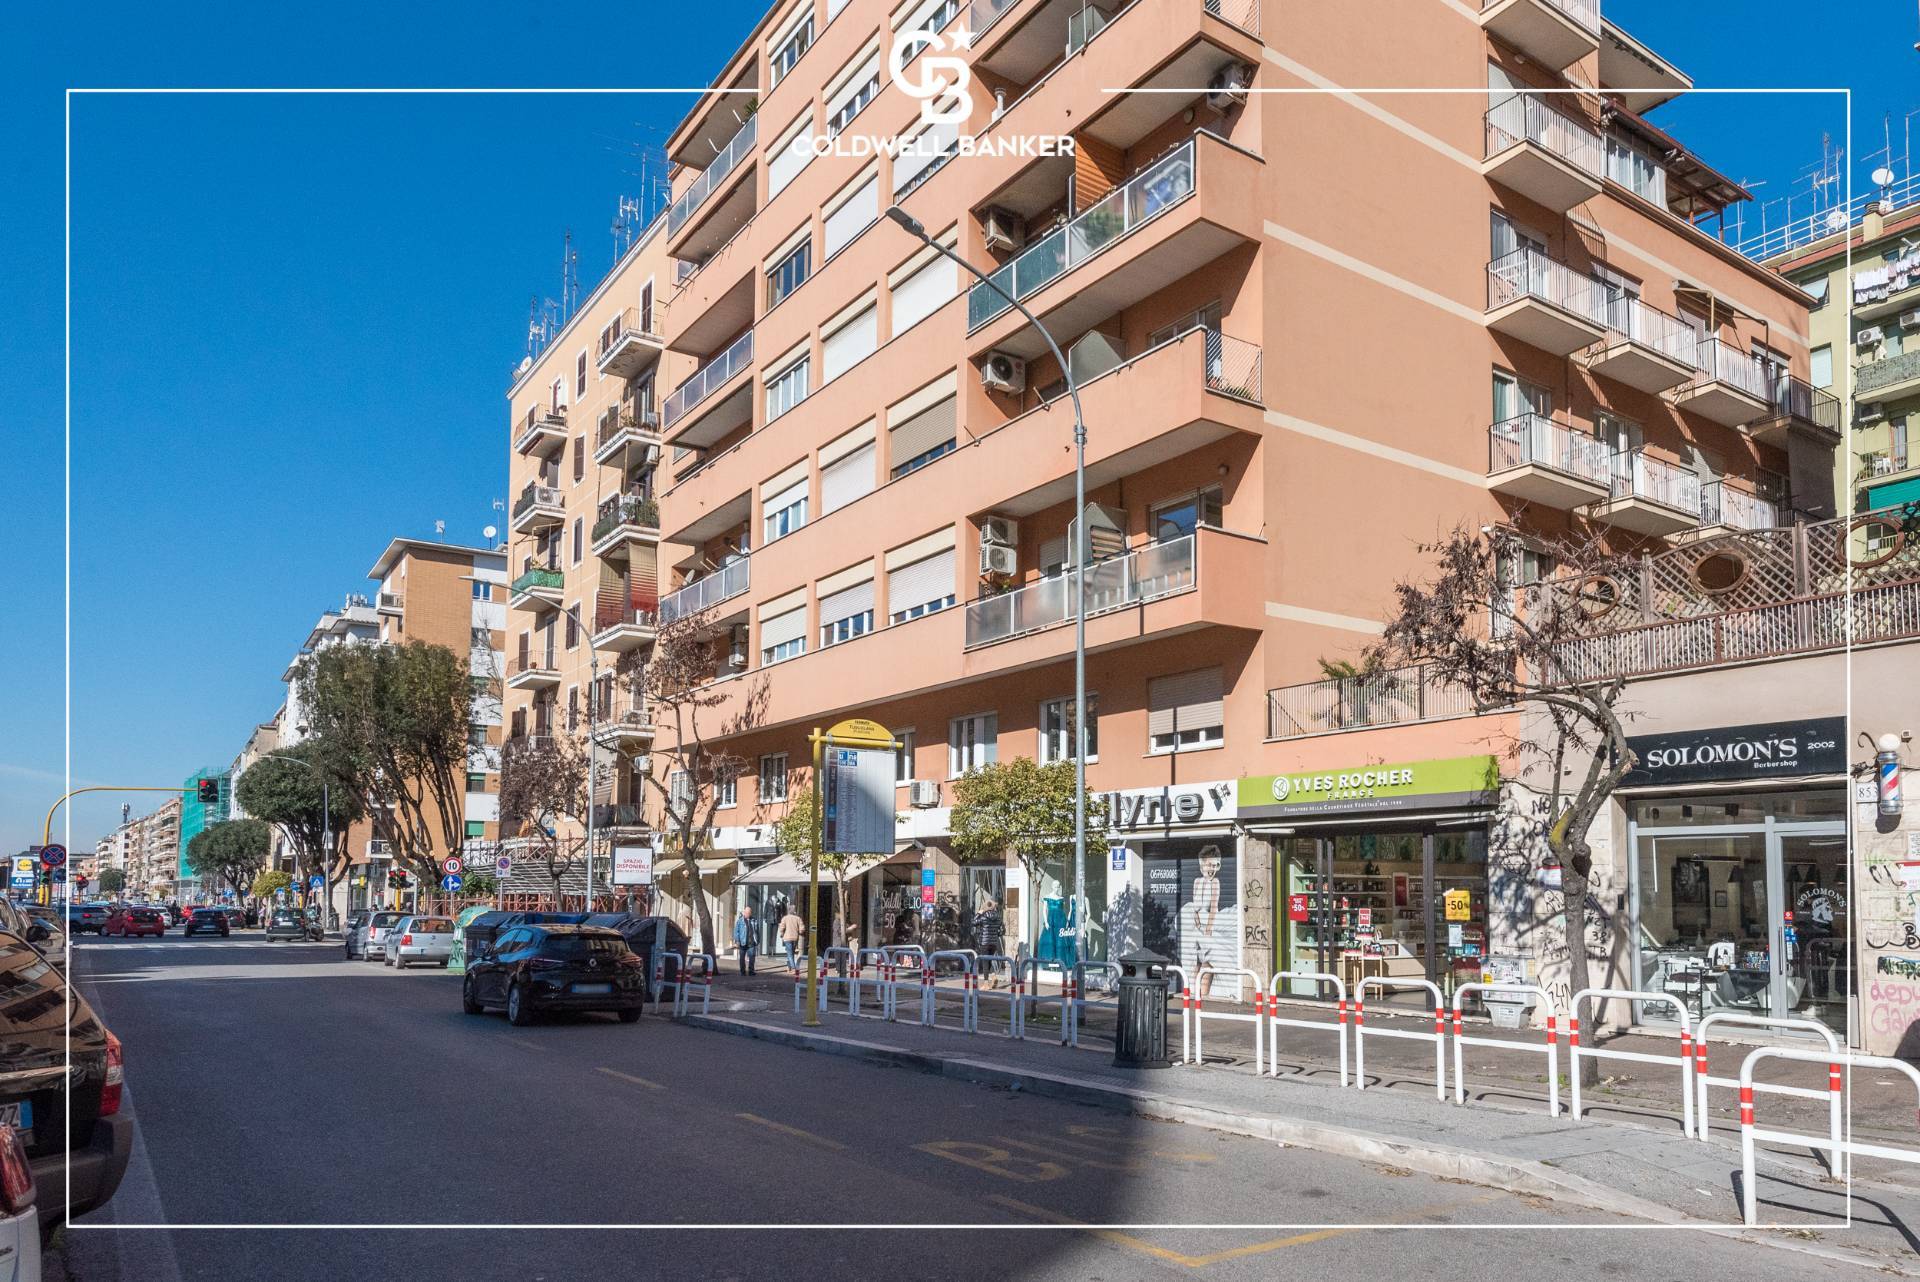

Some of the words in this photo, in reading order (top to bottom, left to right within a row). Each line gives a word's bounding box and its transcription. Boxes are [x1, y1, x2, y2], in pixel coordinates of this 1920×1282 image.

[1647, 738, 1798, 768] SOLOMON'S
[1807, 741, 1836, 750] 2002
[1293, 776, 1334, 793] YVES
[1339, 768, 1414, 790] ROCHER
[1327, 789, 1374, 800] FRANCE
[448, 862, 458, 870] 10
[1447, 900, 1469, 911] -50%
[1797, 887, 1847, 908] SOLOMON'S
